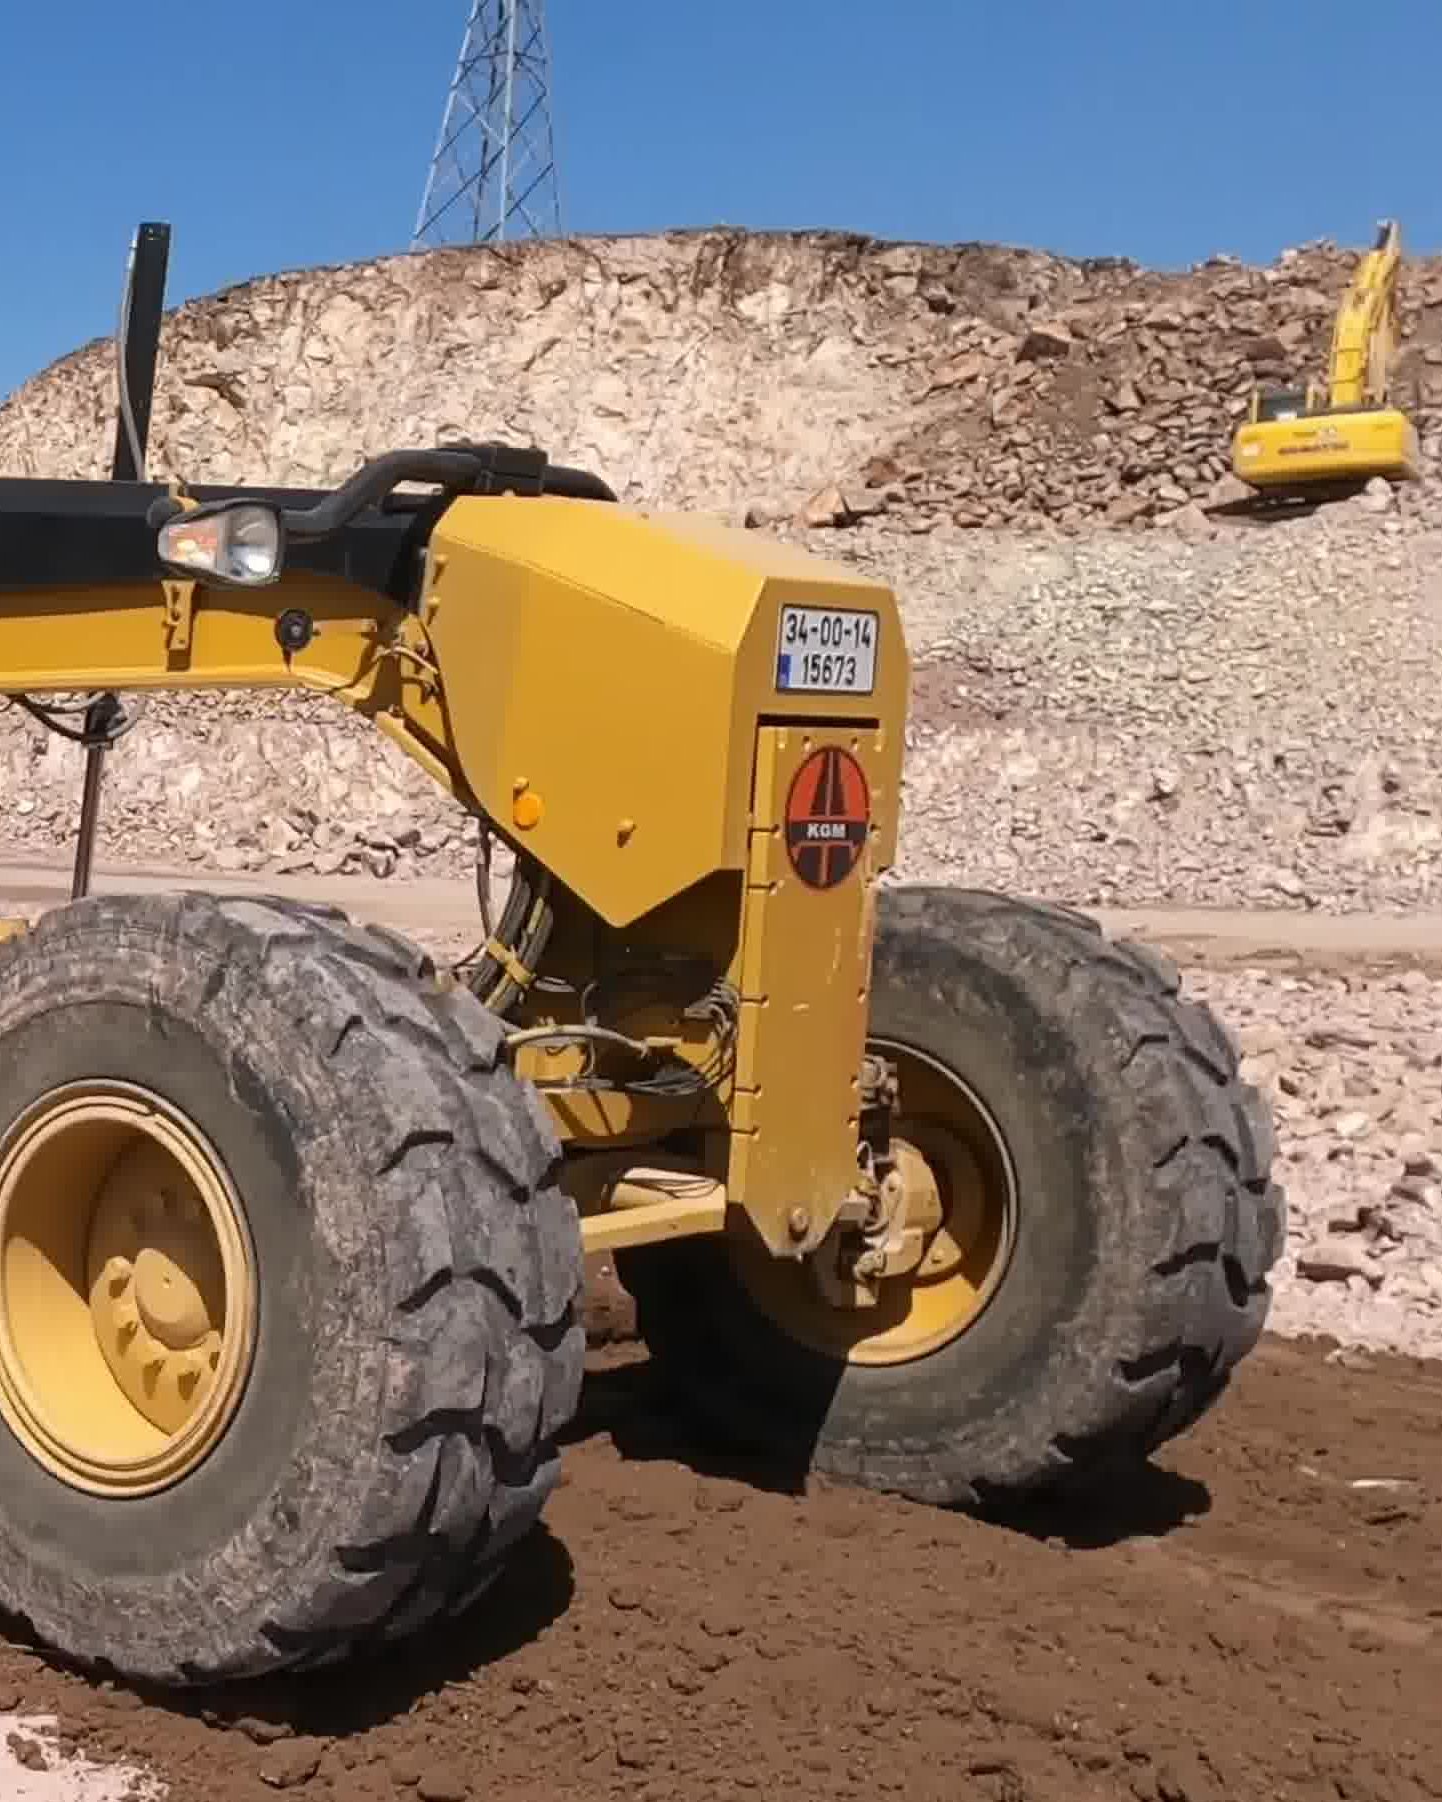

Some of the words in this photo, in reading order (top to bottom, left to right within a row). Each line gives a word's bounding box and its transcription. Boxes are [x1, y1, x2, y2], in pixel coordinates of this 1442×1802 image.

[786, 613, 870, 648] 34-00-14
[803, 654, 856, 686] 15673
[807, 823, 846, 839] KGM
